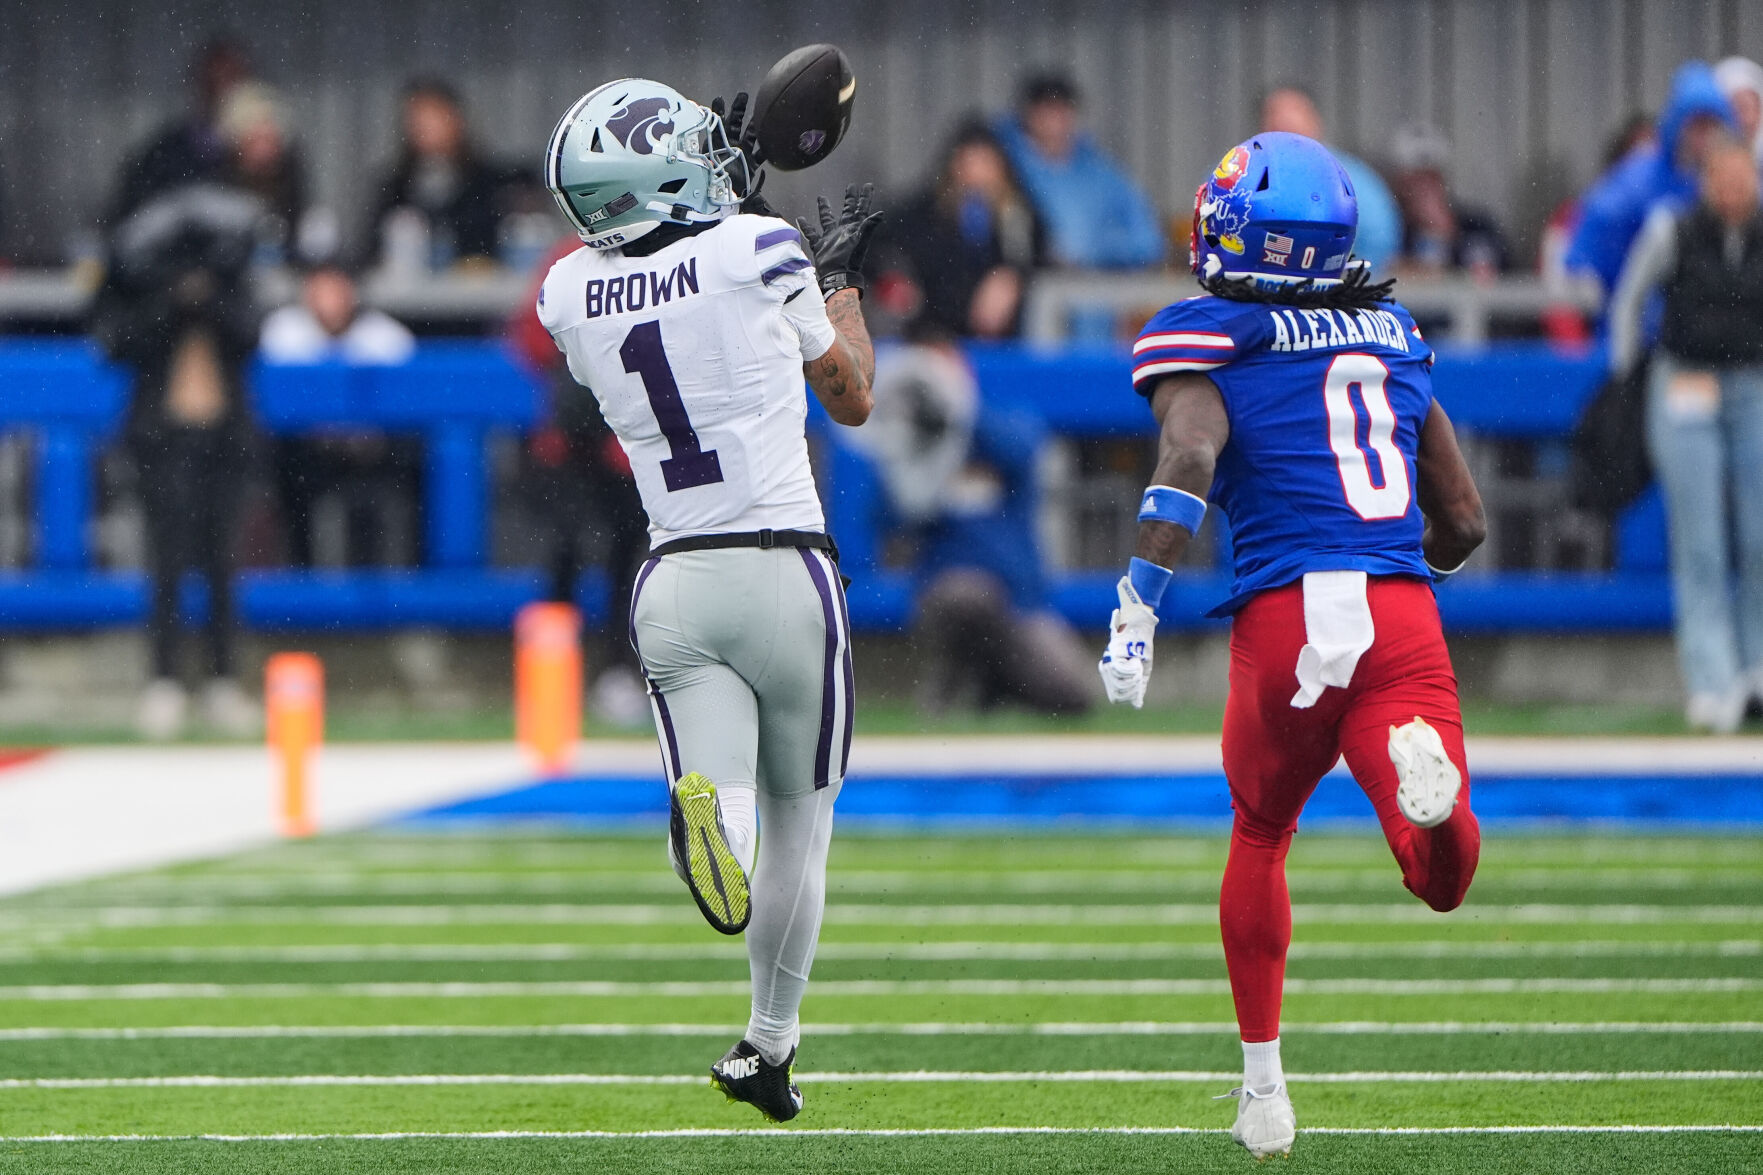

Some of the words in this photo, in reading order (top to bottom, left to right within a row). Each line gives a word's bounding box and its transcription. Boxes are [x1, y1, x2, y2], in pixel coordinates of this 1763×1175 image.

[1301, 246, 1316, 269] 0
[585, 257, 700, 318] BROWN
[1270, 308, 1409, 352] ALEXANDER
[619, 319, 724, 492] 1
[1323, 352, 1411, 521] 0
[721, 1054, 760, 1080] NIKE
